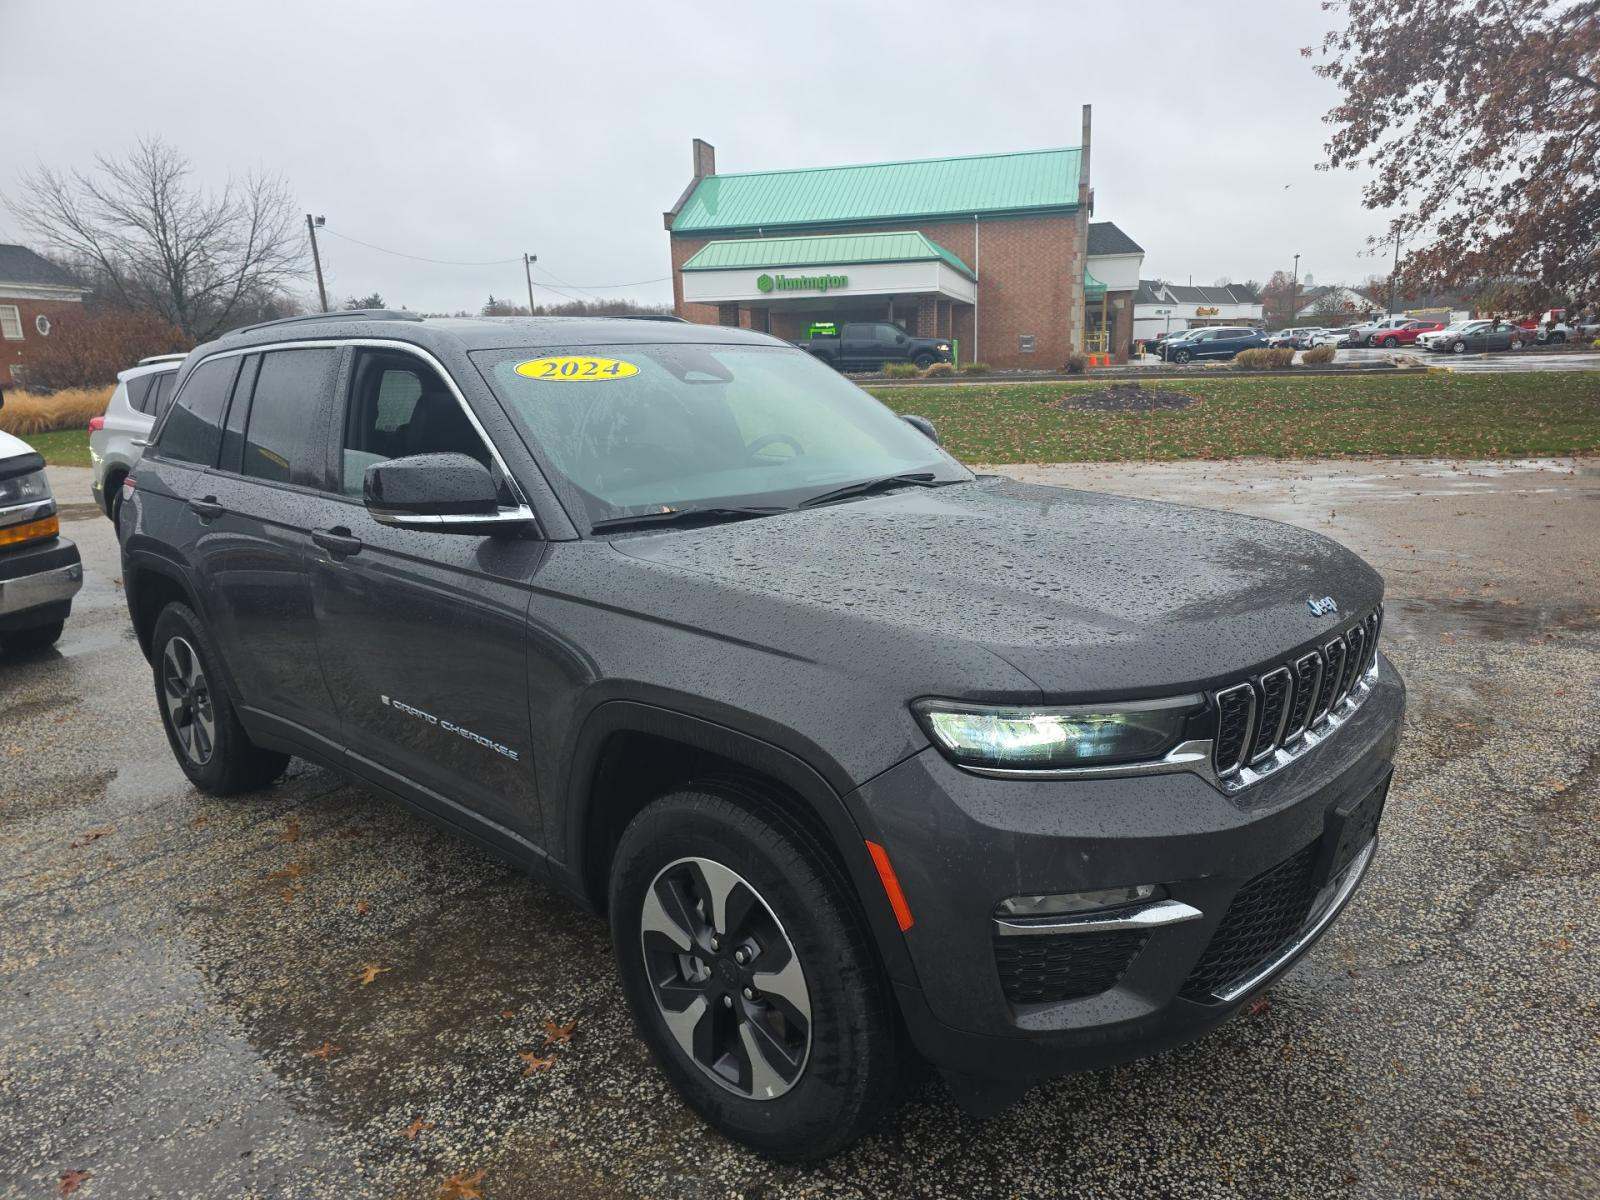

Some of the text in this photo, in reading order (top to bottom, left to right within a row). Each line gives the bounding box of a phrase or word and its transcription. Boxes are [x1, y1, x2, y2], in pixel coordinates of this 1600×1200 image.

[775, 273, 848, 292] Huntington
[540, 361, 621, 377] 2024
[1306, 596, 1338, 616] Jeep
[392, 699, 520, 761] GRAND CHEROKEE
